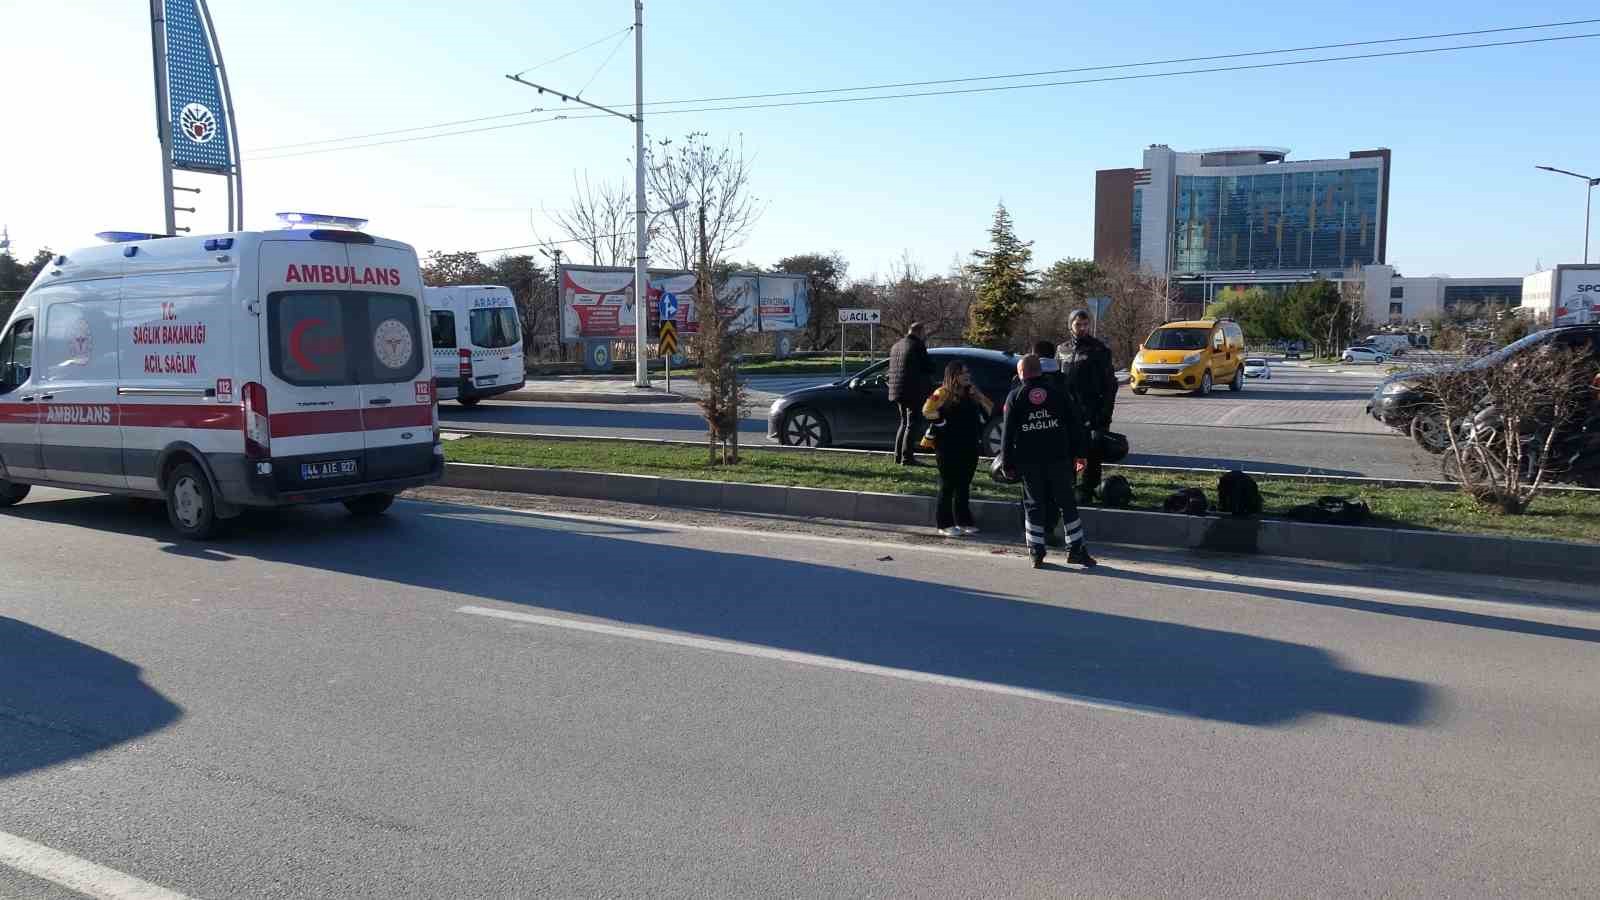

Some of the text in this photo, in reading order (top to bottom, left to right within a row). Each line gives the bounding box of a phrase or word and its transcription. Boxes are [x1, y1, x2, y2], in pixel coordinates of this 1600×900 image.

[286, 264, 401, 286] AMBULANS
[161, 302, 177, 320] T.C.
[133, 322, 160, 344] SAĞLIK
[144, 351, 197, 374] ACİL SAĞLIK
[219, 381, 230, 392] 112
[417, 383, 428, 393] 112
[46, 405, 112, 423] AMBULANS
